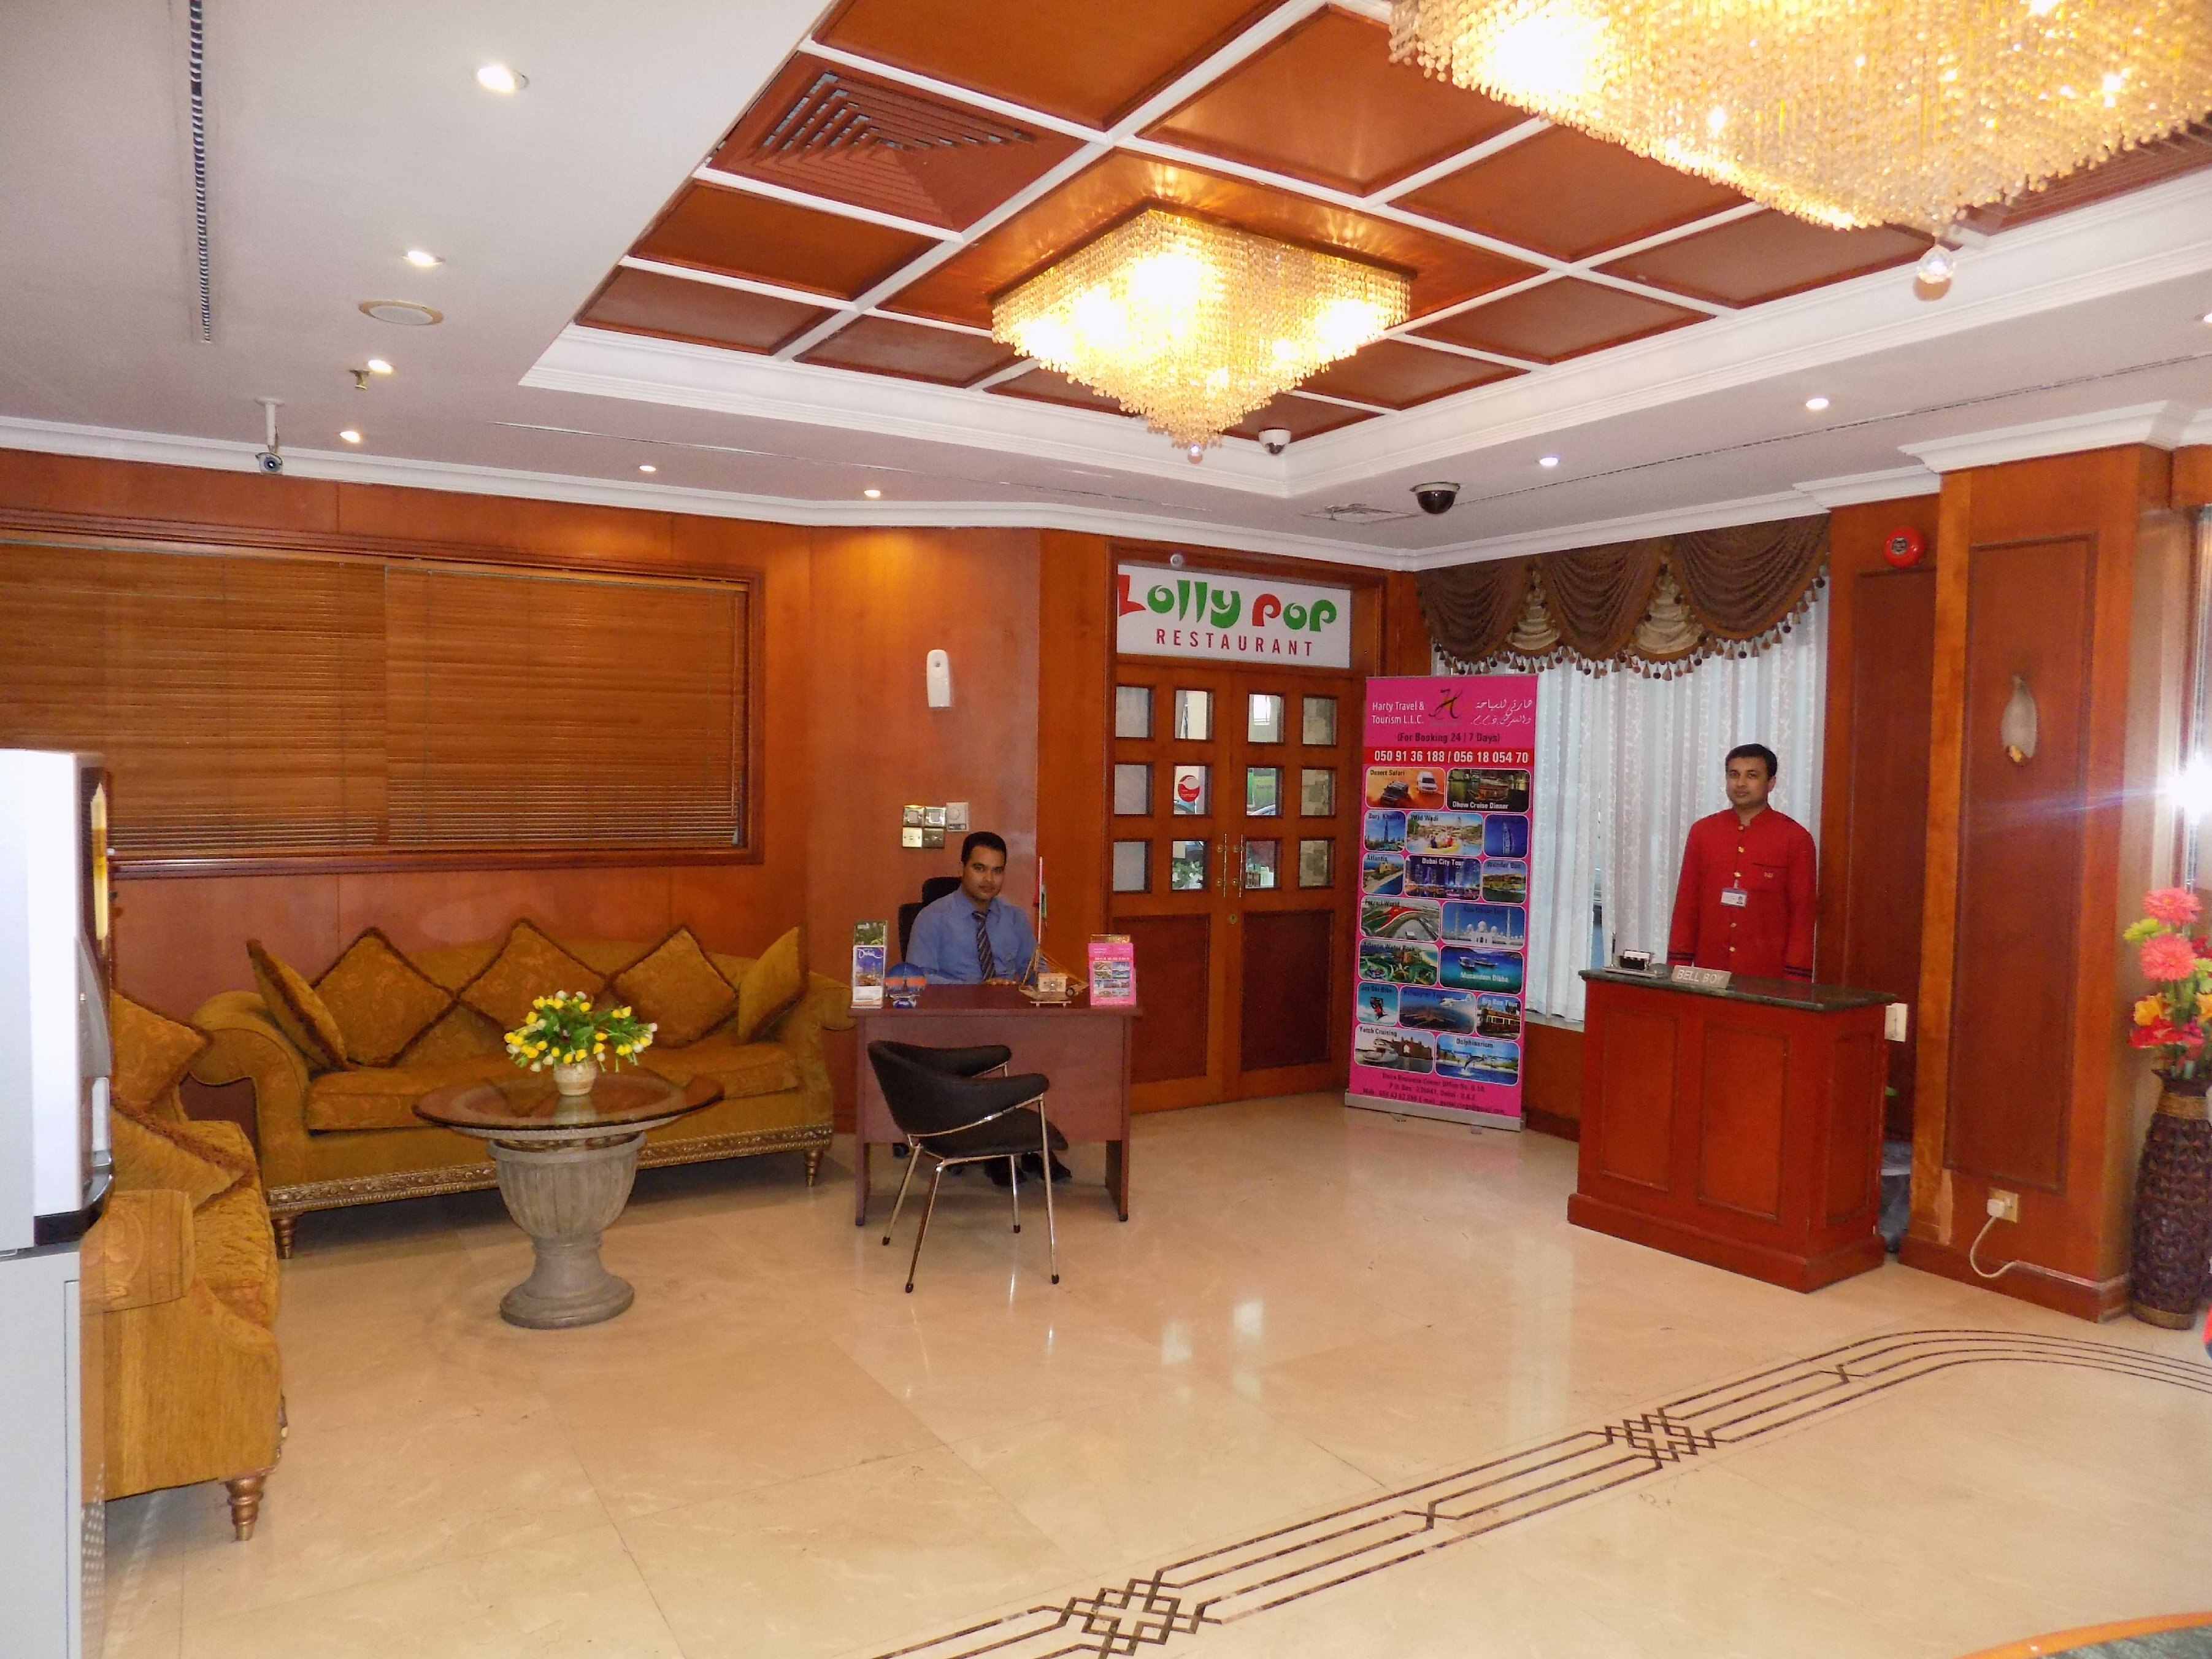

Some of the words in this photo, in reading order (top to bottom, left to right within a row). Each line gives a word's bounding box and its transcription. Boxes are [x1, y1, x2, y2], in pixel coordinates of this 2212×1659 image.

[1117, 574, 1241, 628] Lolly
[1156, 628, 1312, 656] RESTAURANT
[1372, 702, 1393, 712] Harty
[1395, 701, 1417, 710] Travel
[1419, 701, 1424, 710] &
[1371, 715, 1401, 724] Tourism
[1404, 715, 1424, 724] L.L.C.
[1397, 732, 1411, 742] (For
[1415, 733, 1448, 744] Booking
[1451, 733, 1461, 742] 24
[1477, 733, 1500, 744] Days)
[1374, 750, 1393, 761] 050
[1396, 750, 1407, 762] 91
[1410, 750, 1423, 762] 36
[1427, 750, 1444, 763] 188
[1454, 751, 1473, 763] 056
[1477, 752, 1488, 763] 18
[1492, 752, 1512, 763] 054
[1516, 752, 1528, 763] 70
[1676, 969, 1699, 982] BELL
[1702, 972, 1724, 984] BOY
[1482, 997, 1492, 1006] Big
[1375, 1028, 1397, 1037] Cruising
[1456, 1038, 1493, 1048] Dolphinarium
